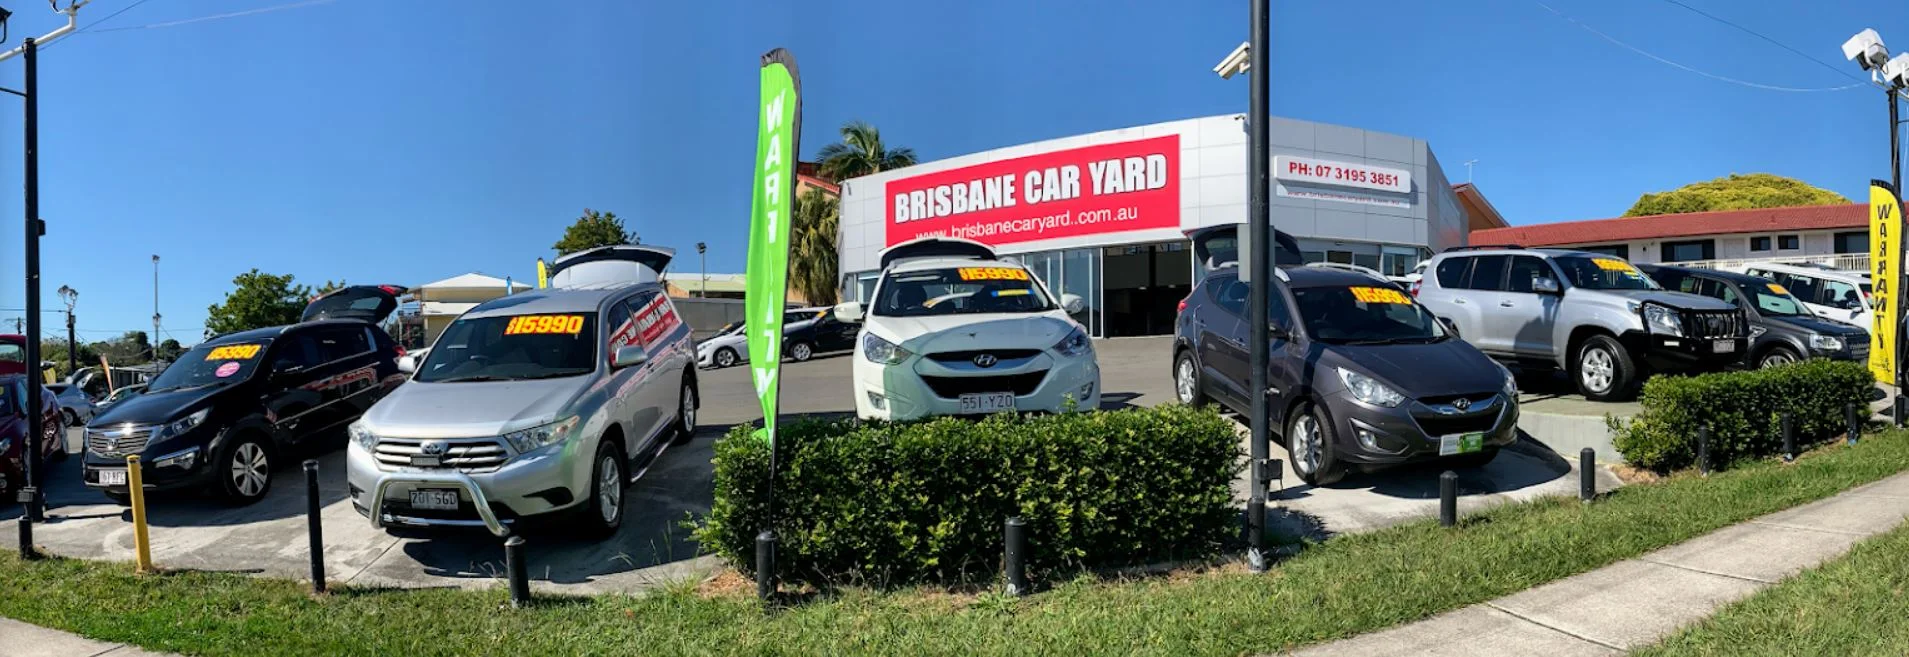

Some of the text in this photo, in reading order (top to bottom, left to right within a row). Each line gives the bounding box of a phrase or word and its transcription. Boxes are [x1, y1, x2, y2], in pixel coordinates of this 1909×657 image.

[1288, 161, 1399, 187] PH: 07 3195 3851
[895, 153, 1168, 224] BRISBANE CAR YARD
[956, 267, 1029, 281] $15990
[504, 314, 585, 335] $15990
